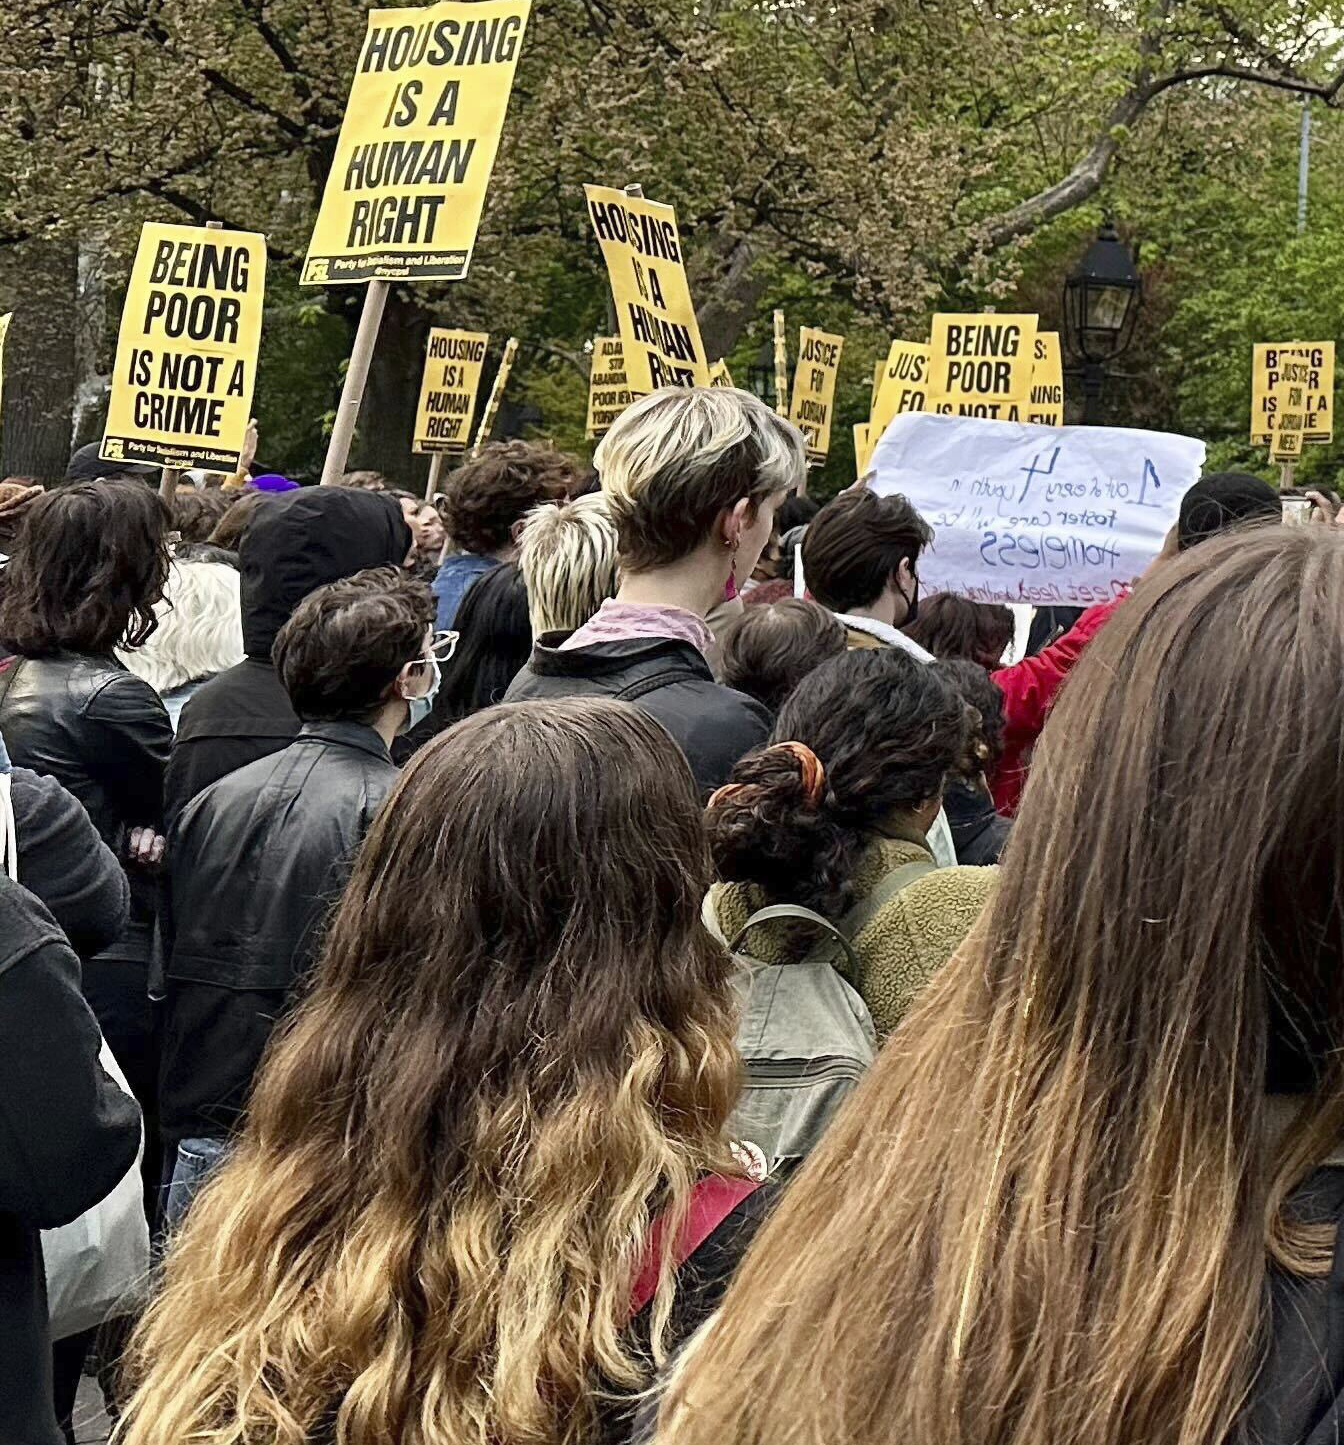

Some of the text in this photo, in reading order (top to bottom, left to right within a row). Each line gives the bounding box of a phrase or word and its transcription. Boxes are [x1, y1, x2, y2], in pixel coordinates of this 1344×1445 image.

[361, 15, 522, 73] HOUSING
[383, 80, 461, 128] IS A
[343, 139, 476, 191] HUMAN
[346, 195, 446, 248] RIGHT
[150, 240, 250, 292] BEING
[334, 259, 358, 270] Party
[405, 256, 423, 265] and
[424, 255, 465, 265] Liberation
[648, 267, 667, 310] A
[143, 290, 241, 343] POOR
[801, 338, 839, 368] JUSCE
[946, 325, 1021, 357] BEING
[128, 348, 245, 397] IS NOT A
[442, 365, 456, 386] IS
[946, 361, 1011, 394] POOR
[134, 391, 225, 436] CRIME
[425, 391, 470, 414] HUMAN
[128, 442, 146, 453] Party
[426, 416, 463, 438] RIGHT
